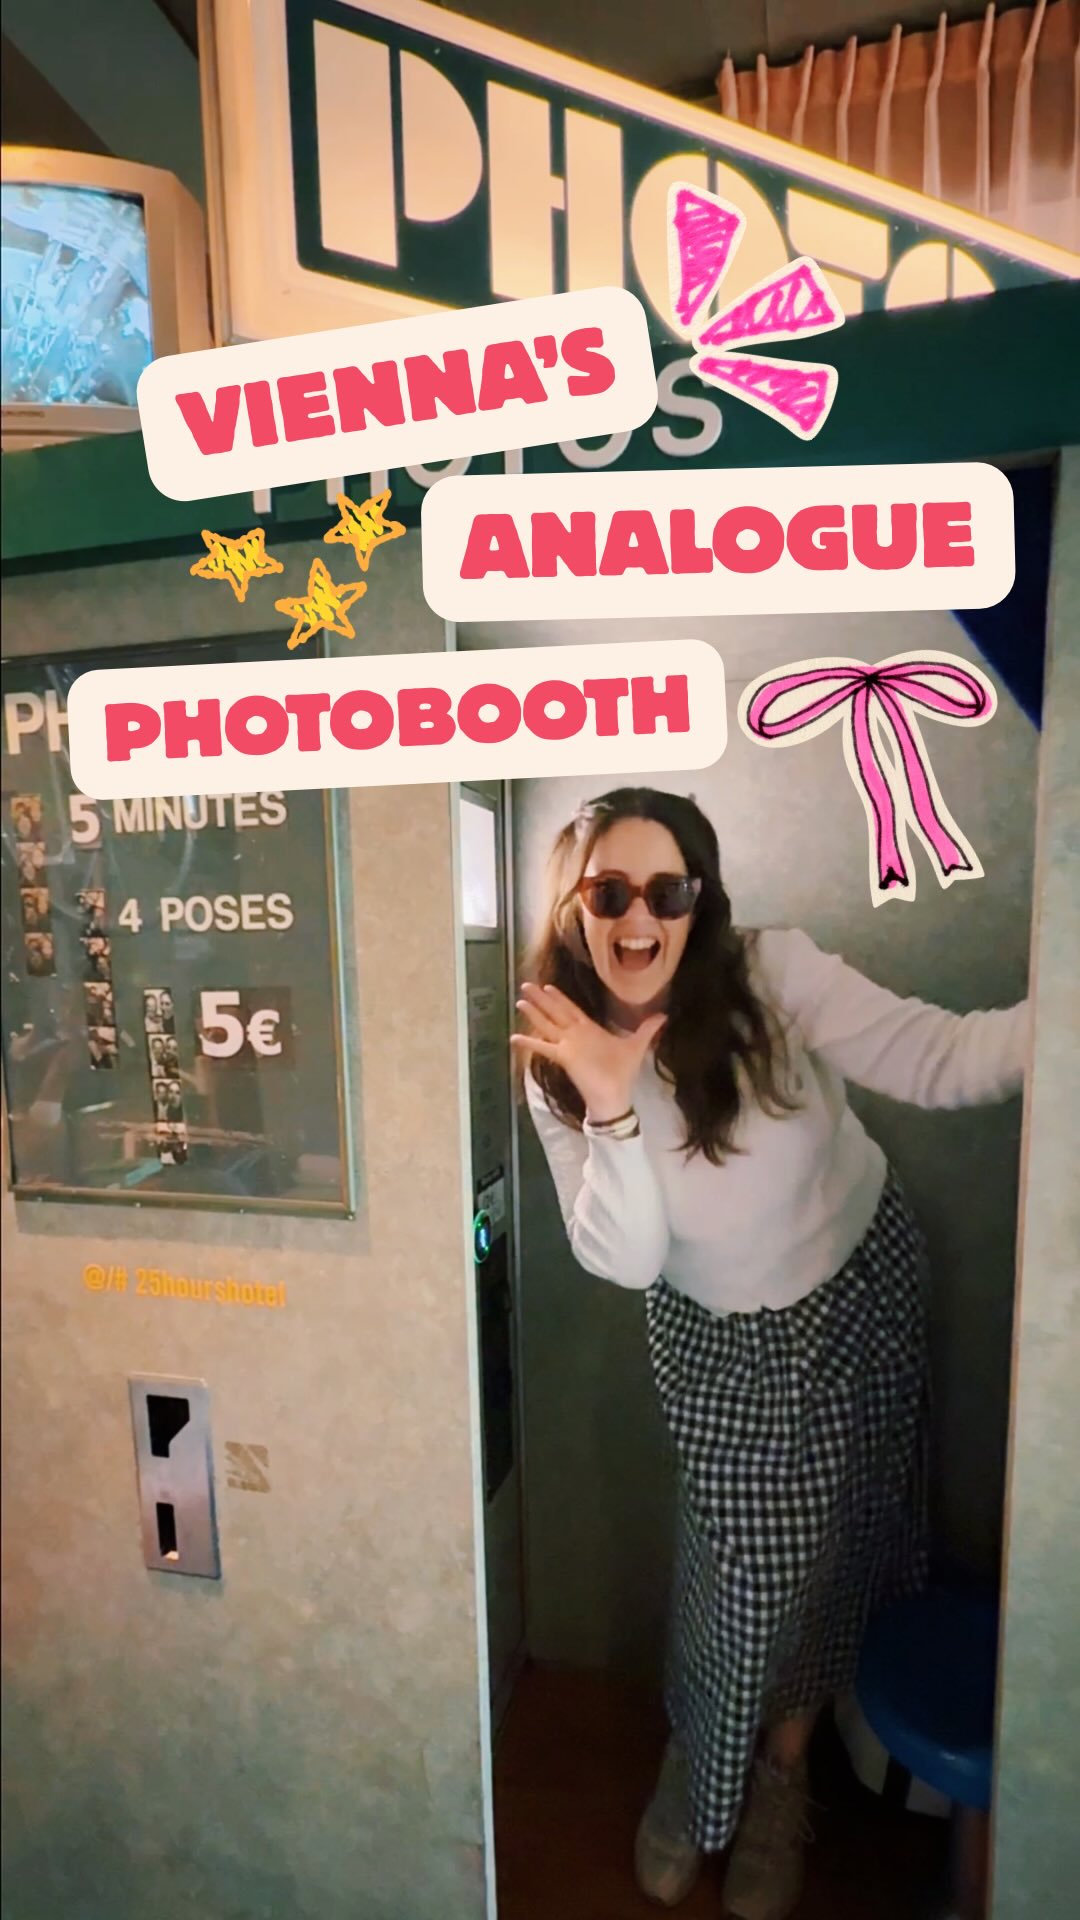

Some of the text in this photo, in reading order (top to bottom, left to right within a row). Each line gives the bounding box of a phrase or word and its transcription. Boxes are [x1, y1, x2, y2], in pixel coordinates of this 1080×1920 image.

[69, 791, 287, 843] 5 MINUTES
[118, 893, 294, 933] 4 POSES
[199, 991, 282, 1058] 5€
[135, 1267, 287, 1308] 25hourshotel
